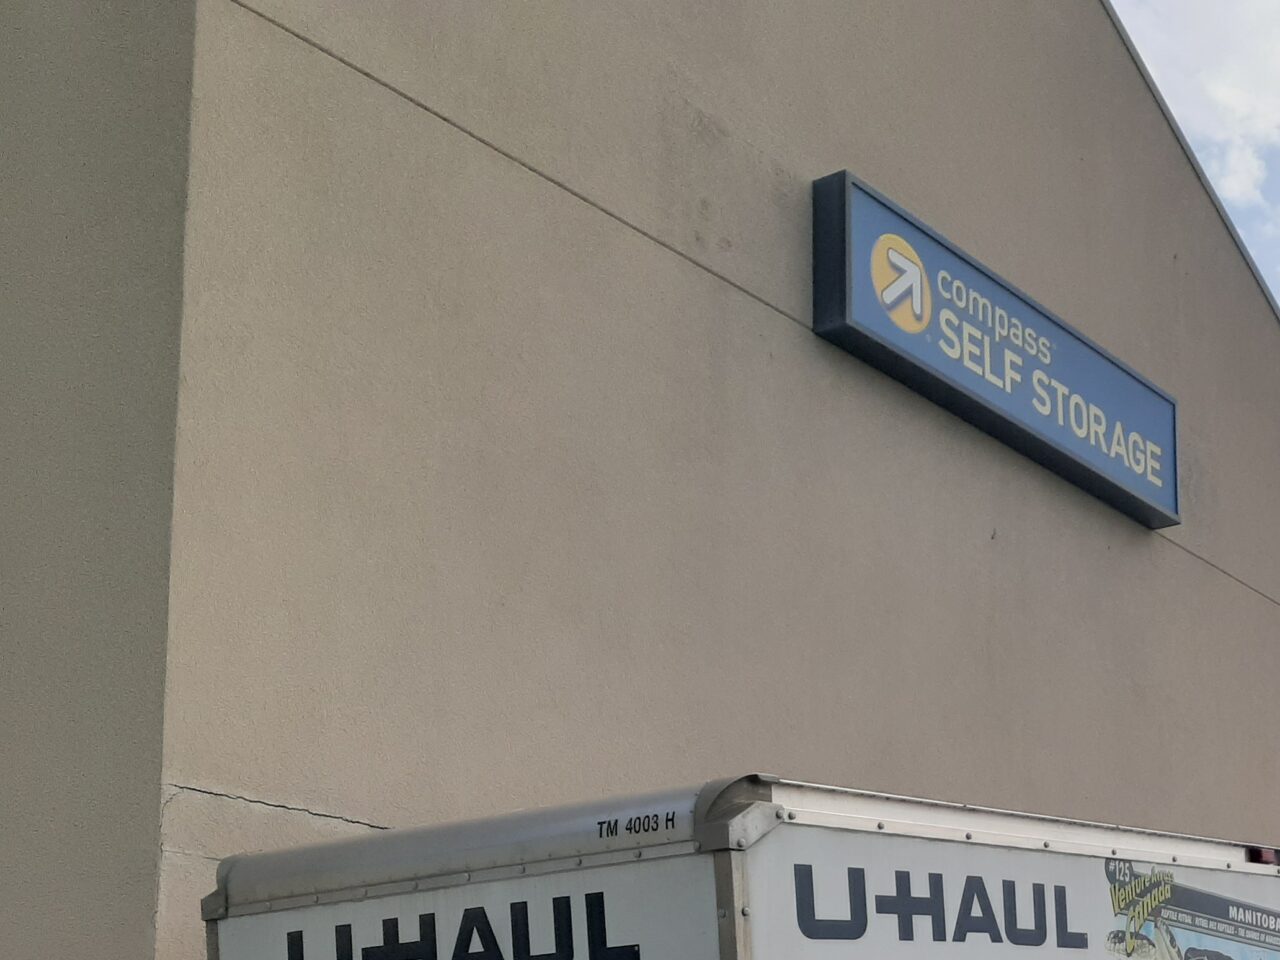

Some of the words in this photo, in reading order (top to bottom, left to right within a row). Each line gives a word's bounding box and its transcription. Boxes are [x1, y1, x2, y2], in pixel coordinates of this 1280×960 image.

[937, 270, 1052, 365] compass
[938, 307, 1023, 394] SELF
[1032, 368, 1163, 488] STORAGE
[597, 819, 618, 838] TM
[625, 814, 659, 834] 4003
[665, 811, 675, 830] H
